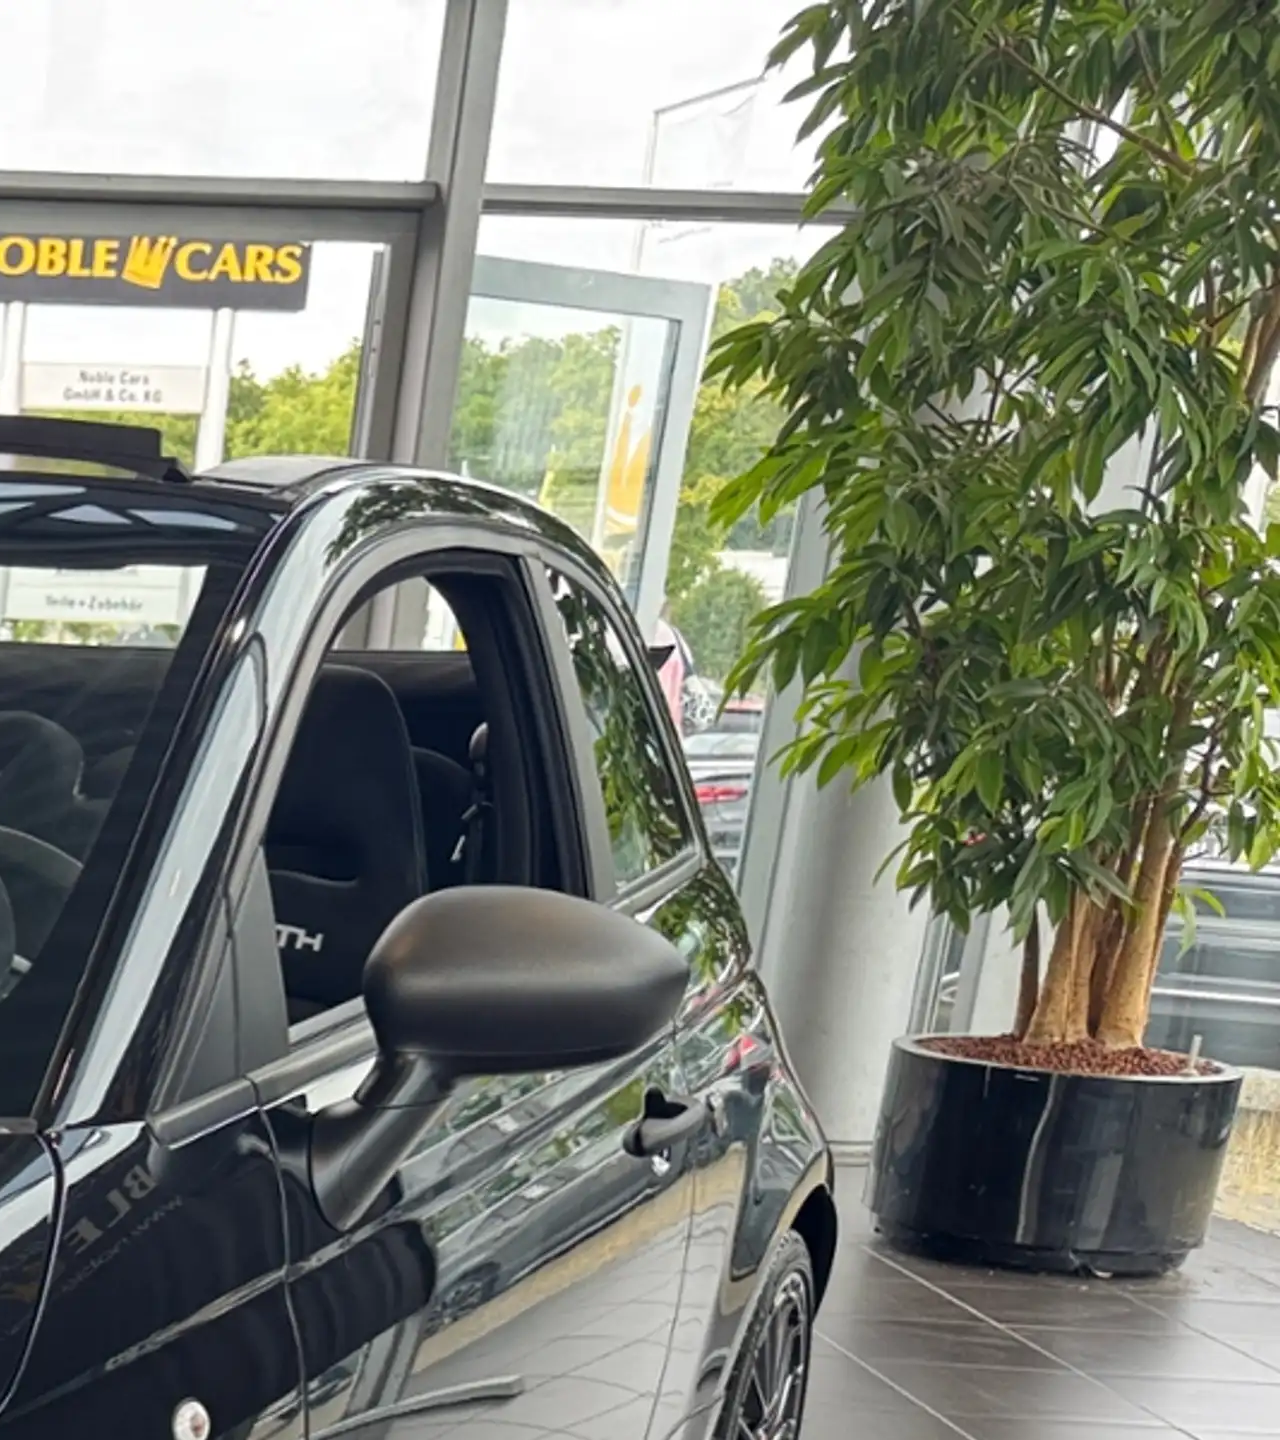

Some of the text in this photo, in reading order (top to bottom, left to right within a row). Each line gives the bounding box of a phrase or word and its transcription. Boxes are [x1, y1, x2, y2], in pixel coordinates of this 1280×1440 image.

[174, 241, 303, 284] CARS
[79, 370, 149, 385] Noble Cars
[63, 386, 101, 402] GmbH
[104, 388, 114, 402] &
[143, 389, 162, 404] KG
